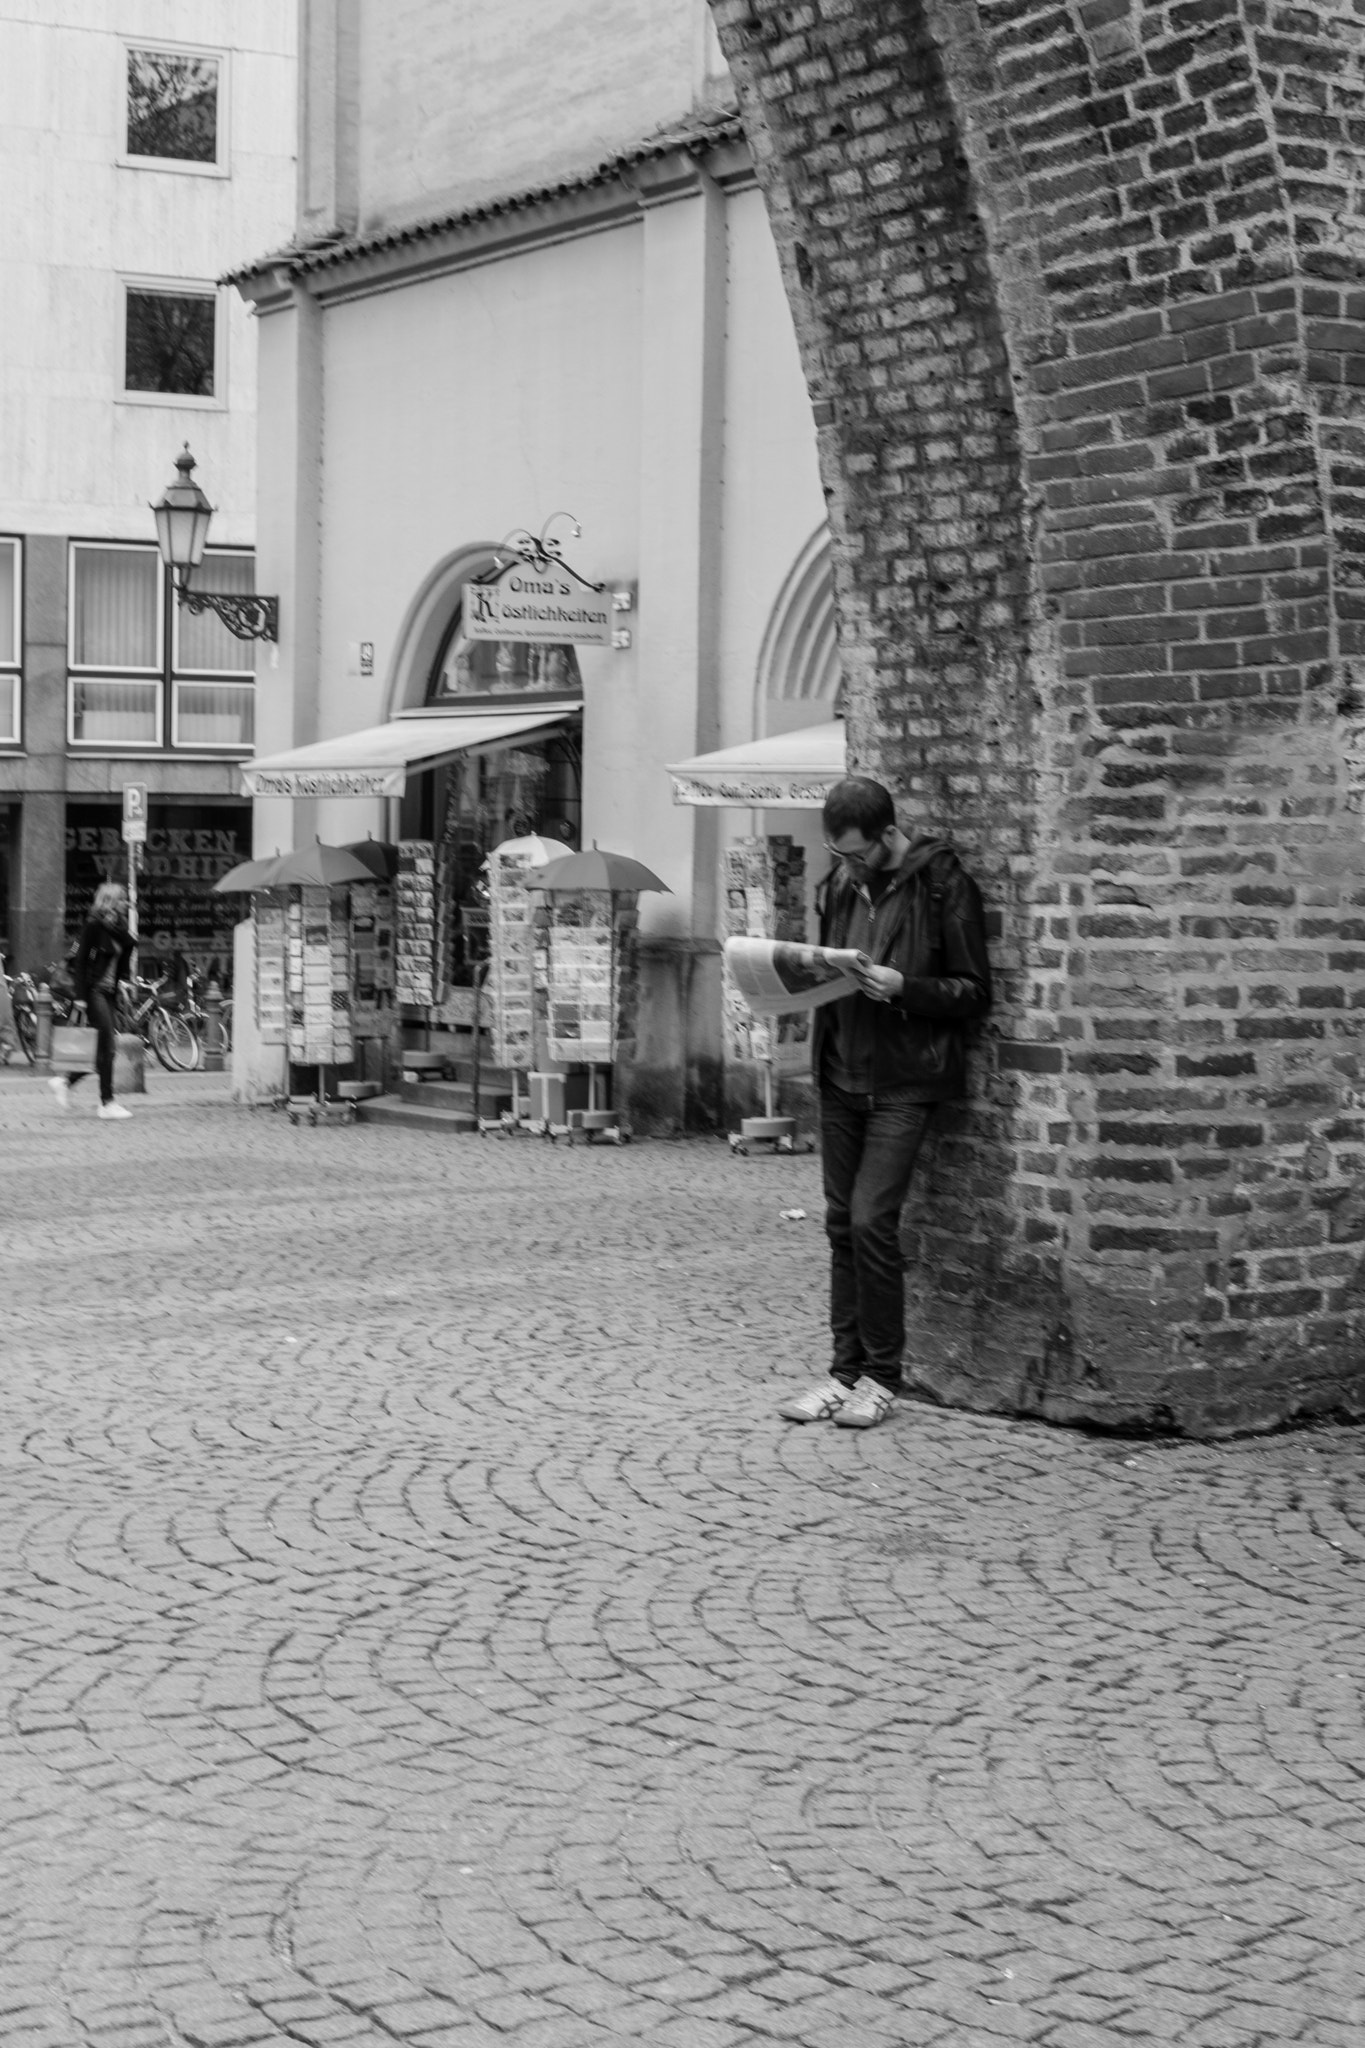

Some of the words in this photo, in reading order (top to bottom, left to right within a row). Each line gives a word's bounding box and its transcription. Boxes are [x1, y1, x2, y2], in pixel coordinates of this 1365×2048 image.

[509, 575, 571, 595] Oma's
[471, 591, 608, 625] Köstlichkeiten
[126, 788, 141, 818] P
[65, 826, 238, 854] GEBCKEN
